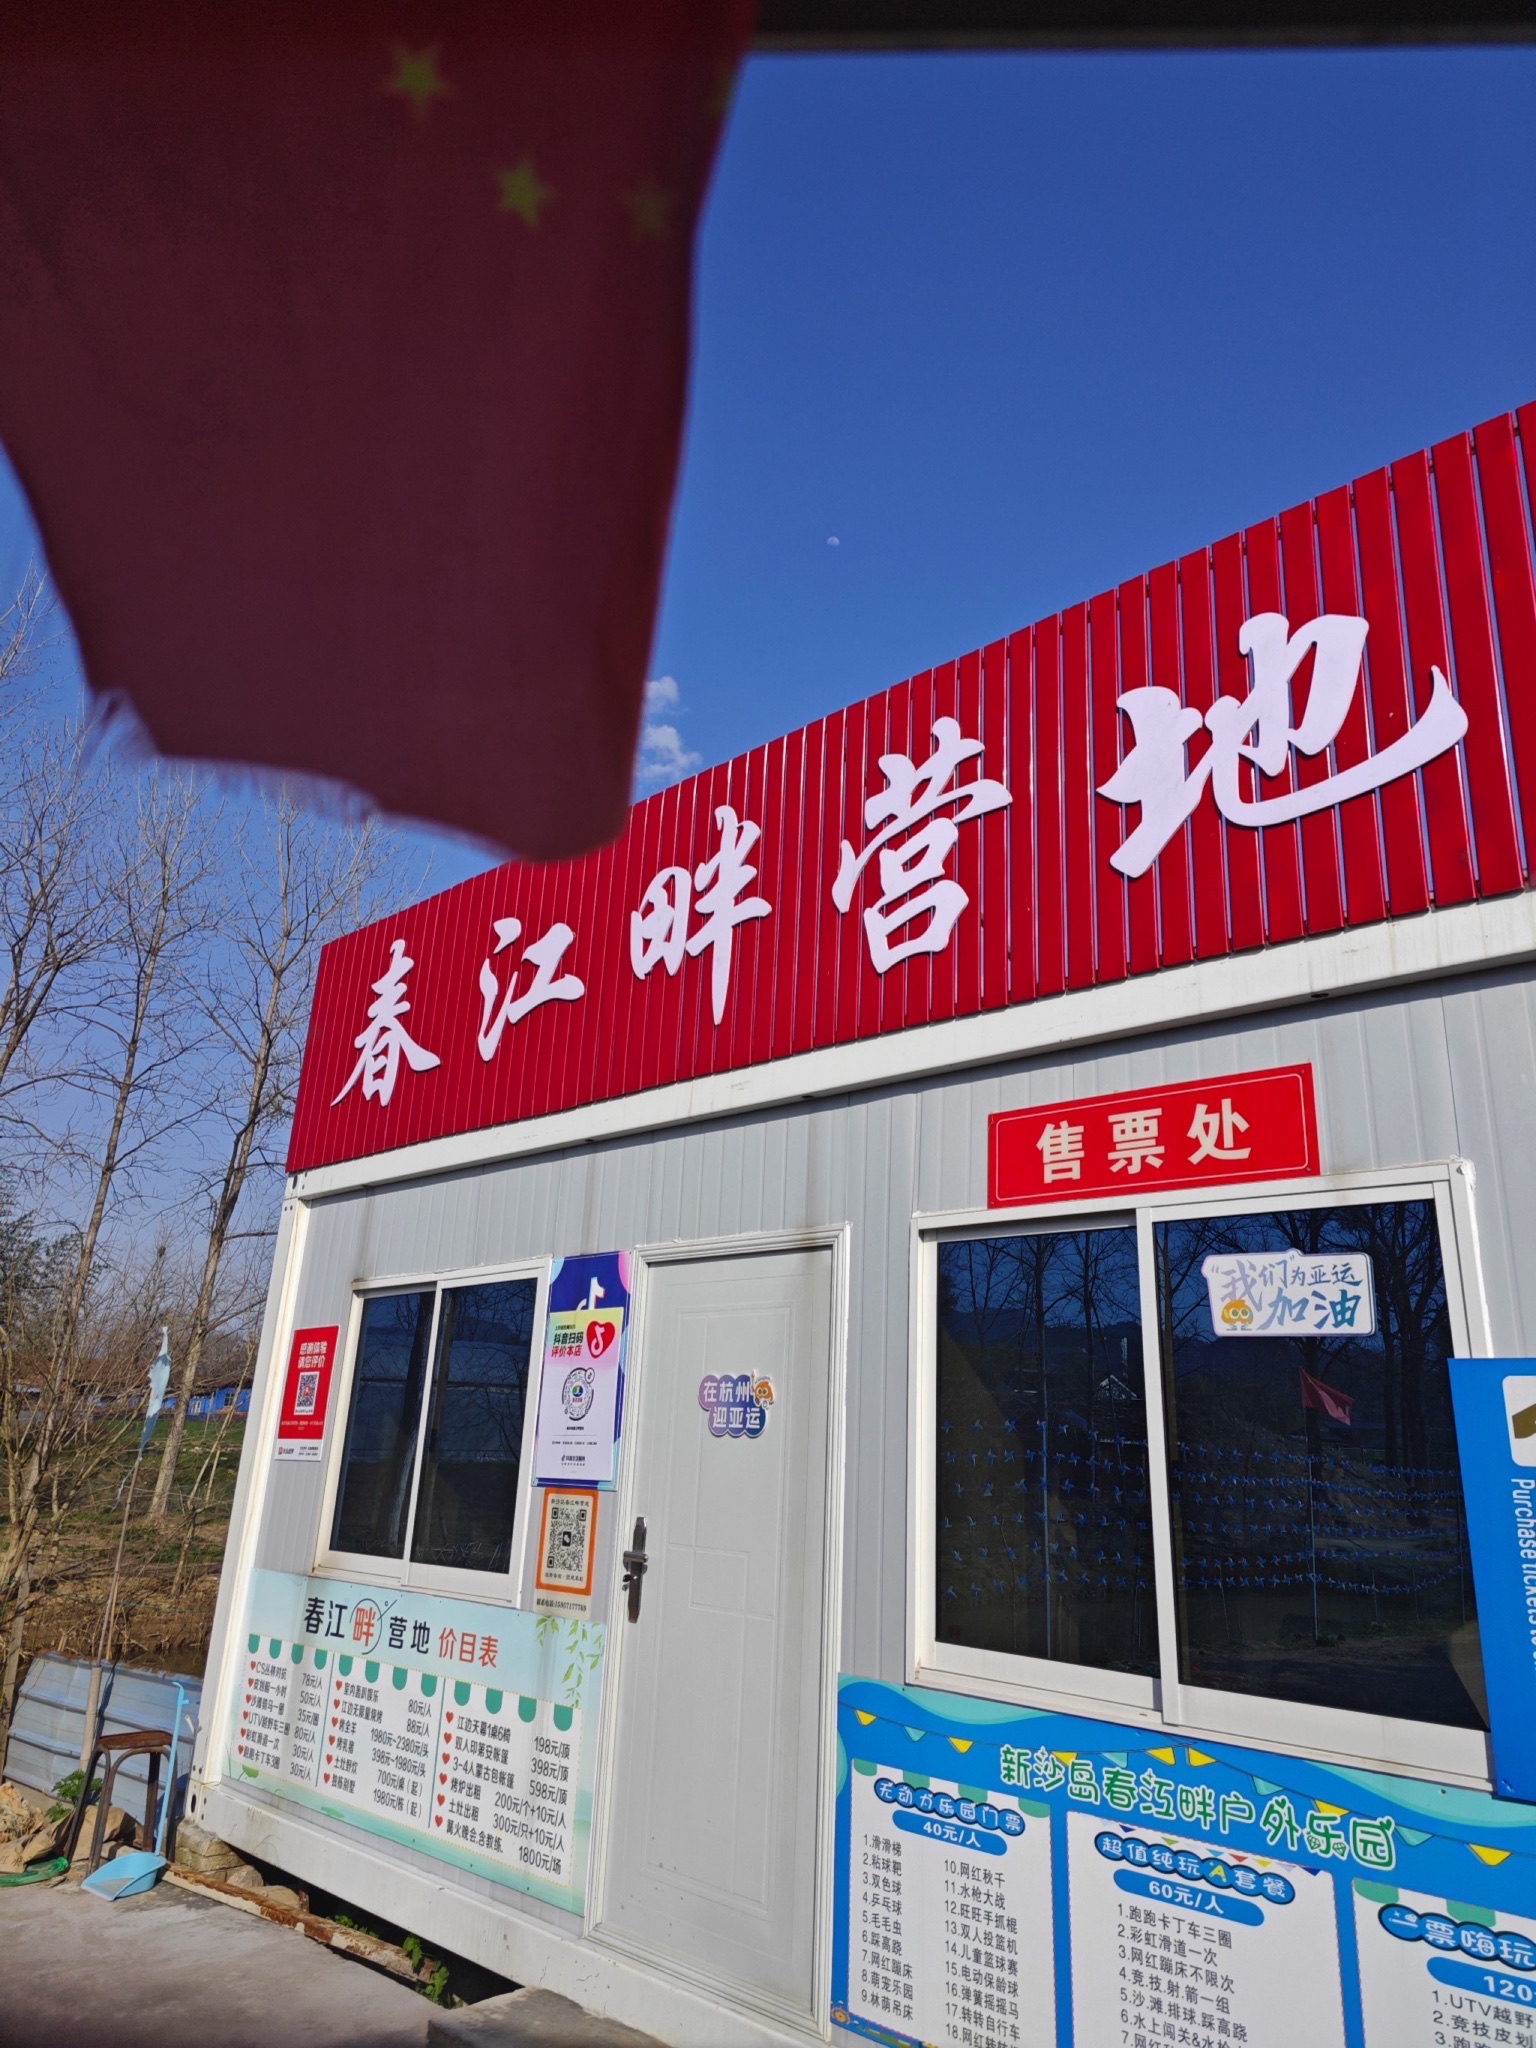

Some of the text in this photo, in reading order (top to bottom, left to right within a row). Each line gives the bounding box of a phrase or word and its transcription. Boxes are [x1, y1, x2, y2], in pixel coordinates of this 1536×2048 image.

[330, 611, 1469, 1108] 春江畔营地
[1036, 1098, 1252, 1184] 售票处
[1256, 1287, 1362, 1330] 加油
[552, 1345, 583, 1358] 评价本店
[553, 1331, 584, 1345] 抖音扫码
[703, 1381, 750, 1403] 在杭州
[713, 1406, 761, 1429] 迎亚运
[1511, 1479, 1536, 1560] Purchase
[301, 1673, 323, 1690] 78元/人
[300, 1690, 321, 1708] 50元/人
[408, 1698, 432, 1718] 80元/人
[297, 1708, 320, 1726] 35元/圈
[406, 1718, 430, 1738] 88元/人
[294, 1726, 316, 1744] 80元/人
[457, 1715, 571, 1760] 江边天幕1桌6椅 198元/顶
[292, 1744, 314, 1763] 30元/人
[454, 1736, 570, 1783] 双人印第安帐篷 398元/顶
[289, 1761, 311, 1781] 30元/人
[453, 1756, 568, 1806] 3-4人蒙古包帐篷 598元/顶
[450, 1776, 567, 1829] 烤炉出租 200元/个+10元/人
[1000, 1744, 1397, 1870] 新沙岛春江畔户外乐园
[448, 1799, 565, 1853] 土灶出租 300元/只+10元/人
[922, 1820, 982, 1848] 40元/人
[518, 1845, 562, 1876] 1800元/场
[863, 1833, 902, 1857] 1.滑滑梯
[862, 1852, 903, 1877] 2.粘球靶
[944, 1858, 1006, 1889] 10.网红秋千
[1101, 1836, 1287, 1899] 超值纯玩A套餐
[862, 1871, 902, 1896] 3.双色球
[944, 1879, 1006, 1911] 11.水枪大战
[1148, 1880, 1225, 1915] 60元/人
[862, 1891, 902, 1916] 4.乒乓球
[944, 1898, 1018, 1935] 12.旺旺手抓棍
[862, 1910, 902, 1936] 5.毛毛虫
[945, 1919, 1018, 1956] 13.双人投篮机
[1117, 1903, 1233, 1950] 1.跑跑卡丁车三圈
[862, 1929, 902, 1956] 6.踩高跷
[1117, 1923, 1218, 1968] 2.彩虹滑道一次
[1388, 1912, 1536, 1968] 一票嗨玩
[861, 1949, 913, 1980] 7.网红蹦床
[945, 1940, 1019, 1977] 14.儿童篮球赛
[1118, 1945, 1236, 1995] 3.网红蹦床不限次
[861, 1969, 914, 2001] 8.萌宠乐园
[945, 1960, 1019, 1998] 15.电动保龄球
[1484, 1975, 1536, 2002] 120
[945, 1980, 1019, 2020] 16.弹簧摇摇马
[1432, 1990, 1534, 2029] 1.UTV越野
[945, 2001, 1021, 2041] 17.转转自行车
[946, 2022, 1018, 2048] 18.网红转
[1433, 2010, 1534, 2048] 2.竞技皮划
